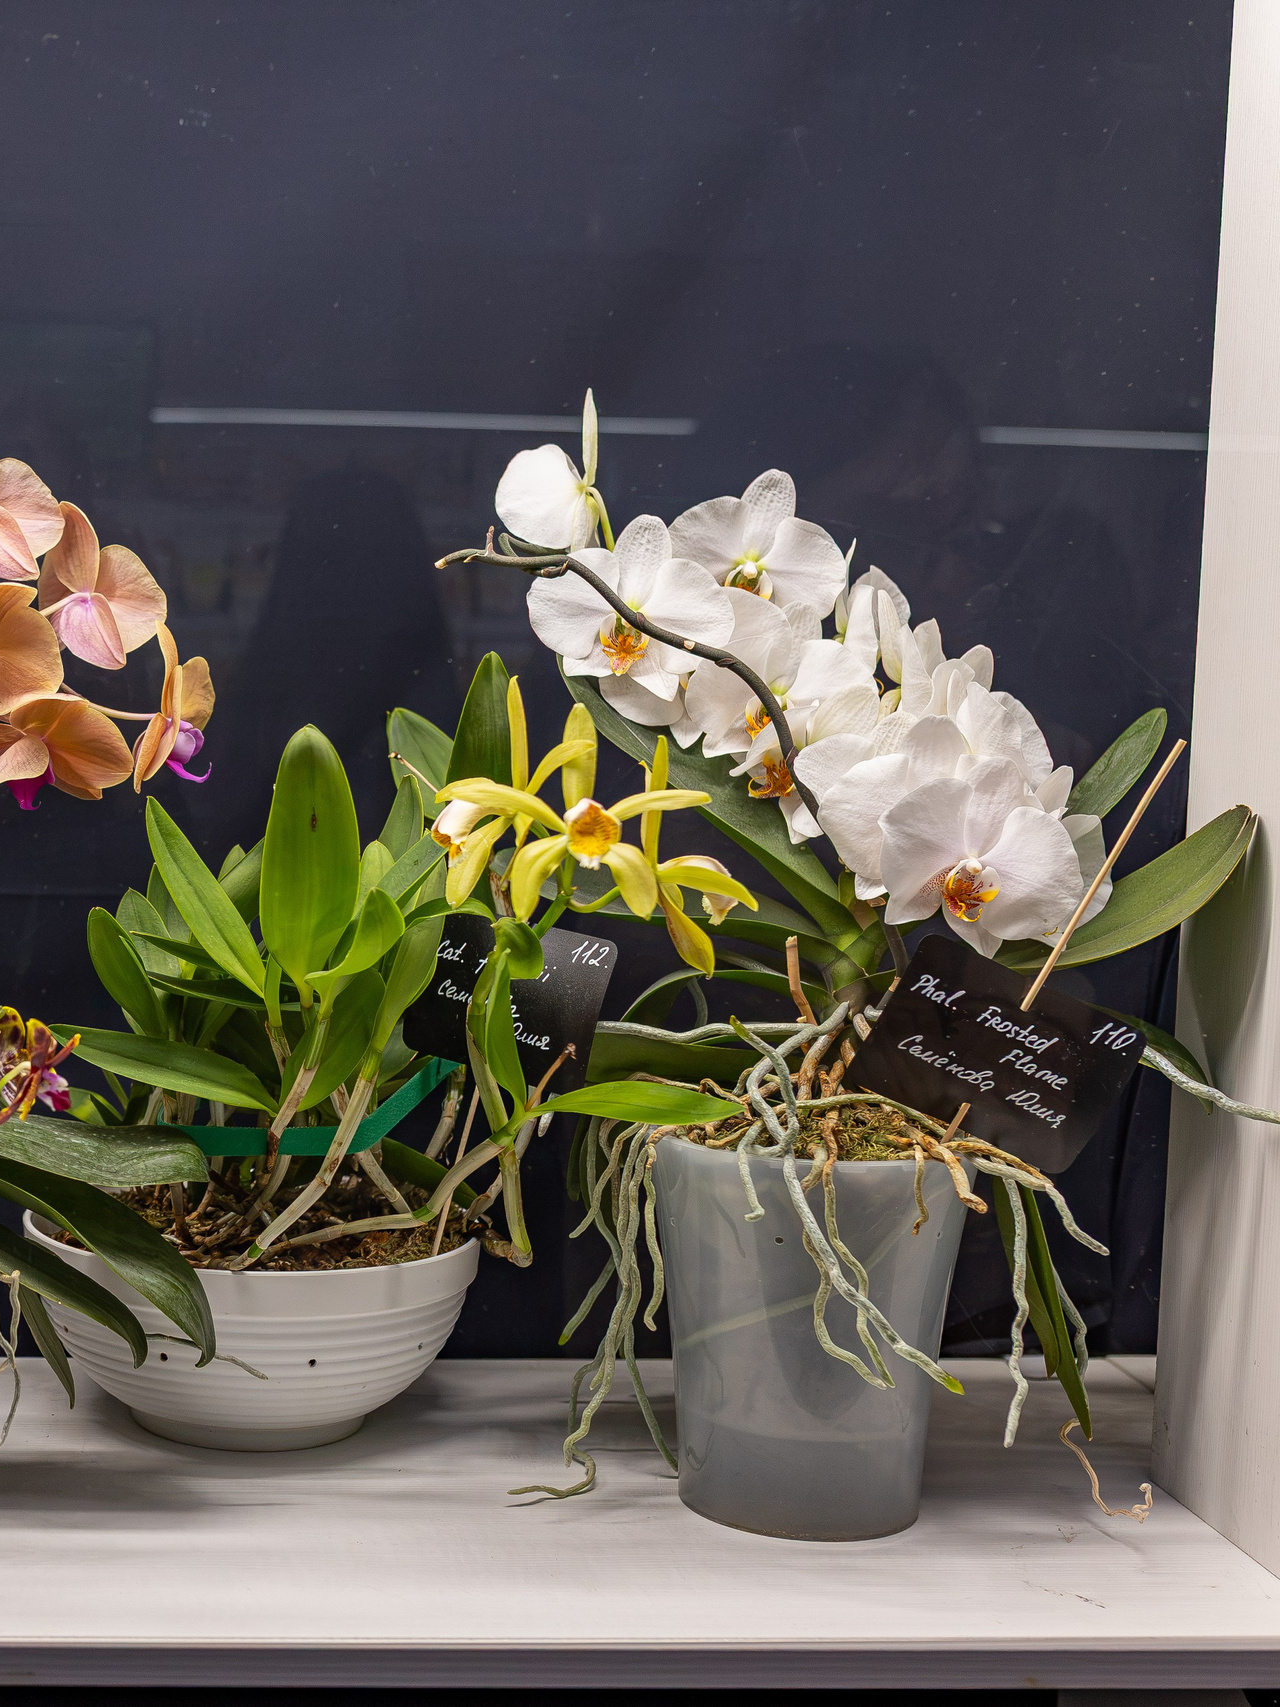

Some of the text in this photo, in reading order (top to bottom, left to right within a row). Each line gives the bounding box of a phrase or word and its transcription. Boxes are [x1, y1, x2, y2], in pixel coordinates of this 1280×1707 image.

[436, 940, 466, 963] Cat.
[910, 973, 966, 1011] Phal.
[976, 1005, 1060, 1055] Frosted
[897, 1035, 1067, 1129] Семёнова Юлия
[999, 1049, 1069, 1091] Flame
